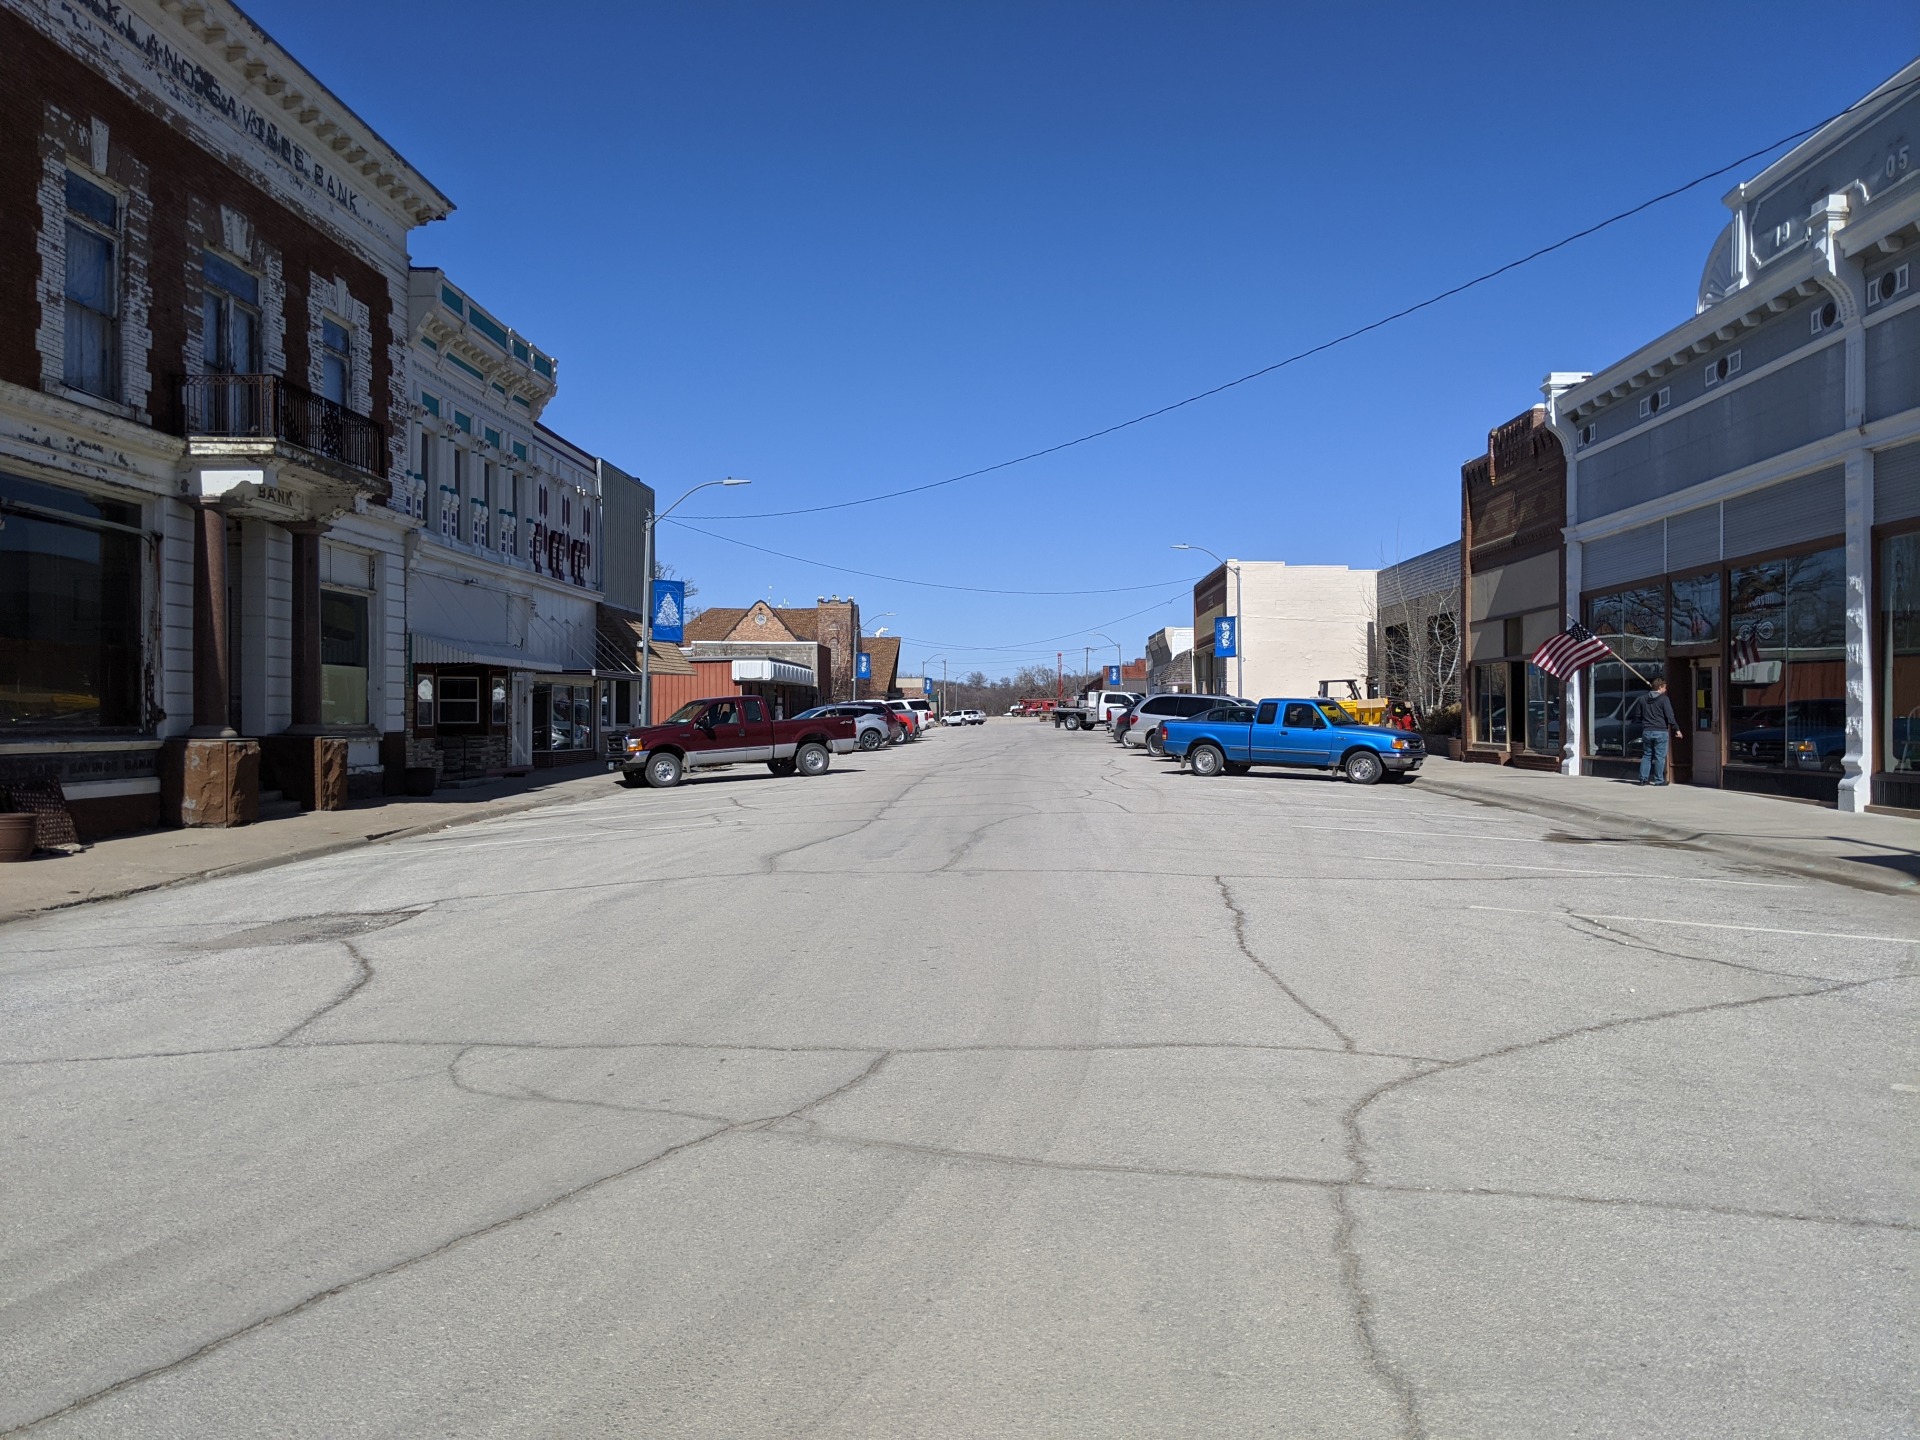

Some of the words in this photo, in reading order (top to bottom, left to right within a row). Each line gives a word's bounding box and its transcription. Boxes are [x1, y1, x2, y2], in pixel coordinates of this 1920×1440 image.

[314, 163, 359, 216] BANK
[1775, 221, 1791, 248] 19
[1886, 144, 1910, 178] 05
[258, 486, 292, 507] BANK
[124, 758, 153, 770] BANK
